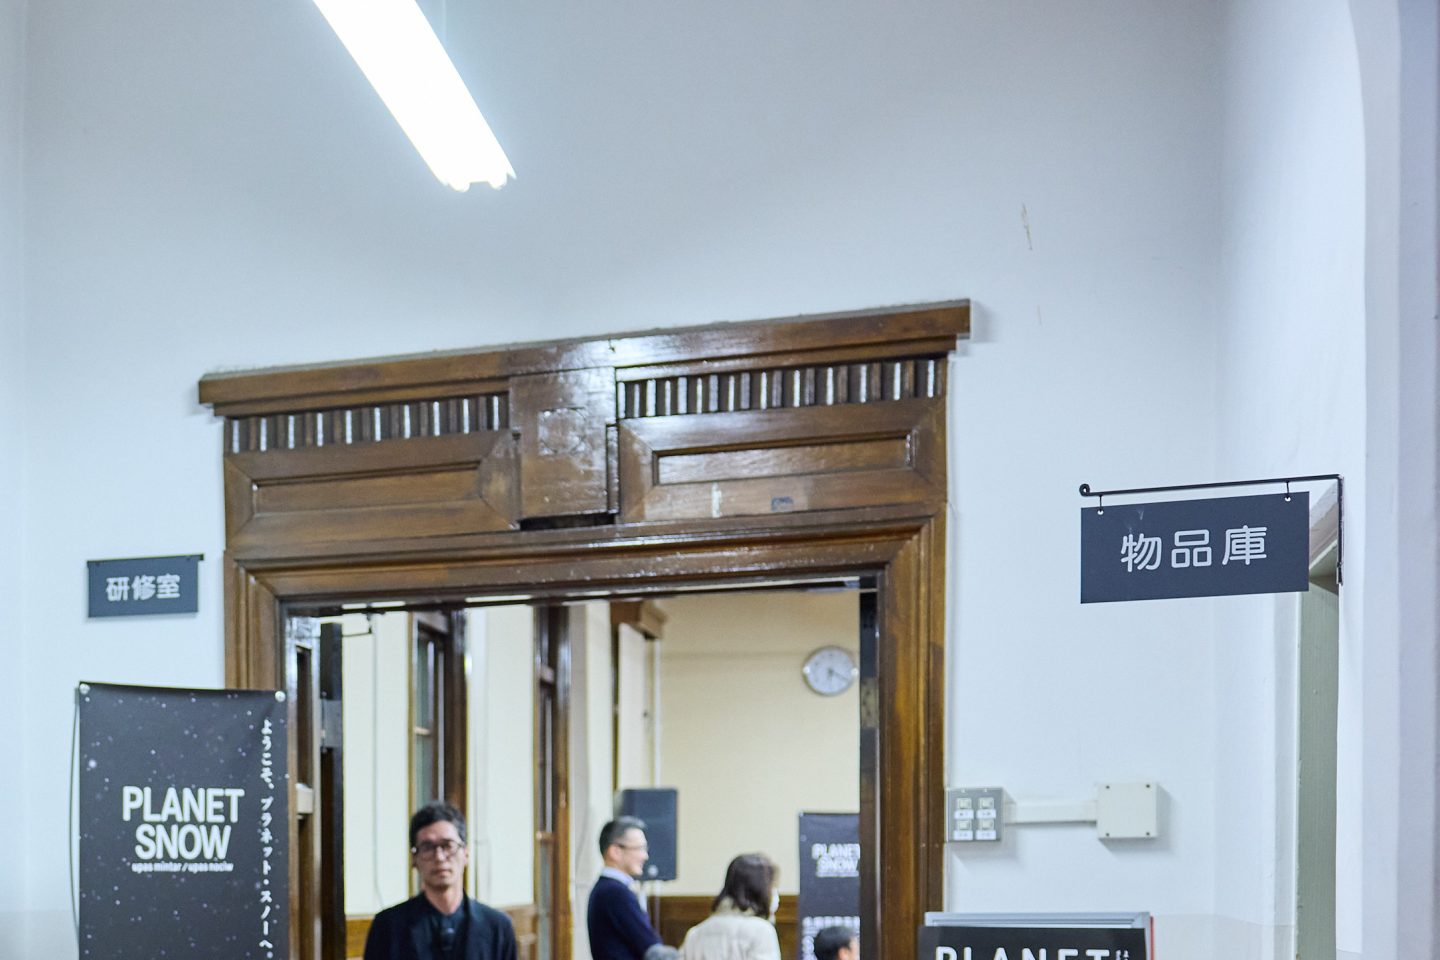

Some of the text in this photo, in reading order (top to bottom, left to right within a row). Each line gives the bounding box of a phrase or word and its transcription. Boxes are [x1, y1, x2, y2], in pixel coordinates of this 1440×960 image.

[1120, 525, 1267, 572] 物品庫
[106, 573, 180, 602] 研修室
[122, 785, 245, 823] PLANET
[135, 823, 232, 860] SNOW
